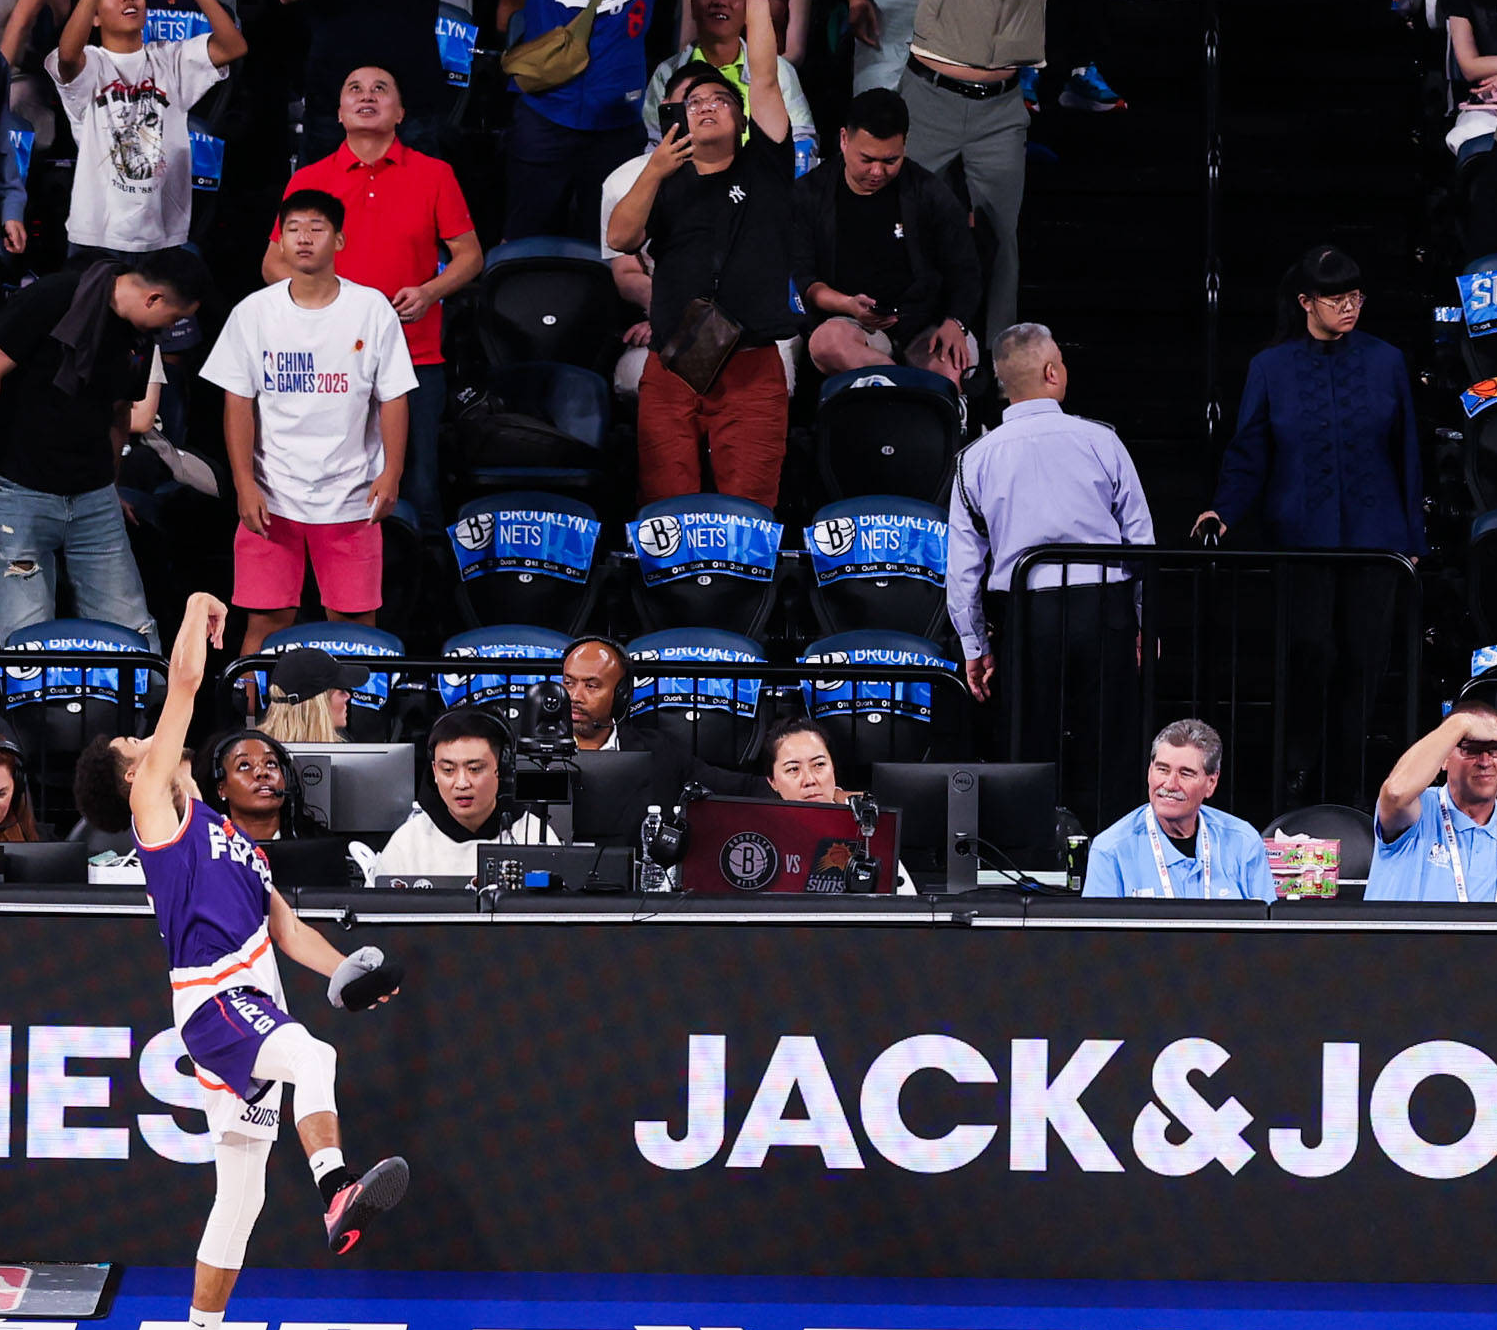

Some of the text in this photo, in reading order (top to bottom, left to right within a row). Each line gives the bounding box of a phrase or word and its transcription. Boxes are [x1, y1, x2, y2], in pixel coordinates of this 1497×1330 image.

[276, 351, 315, 373] CHINA
[276, 372, 349, 394] GAMES 2025
[497, 524, 543, 547] NETS
[686, 528, 728, 550] NETS
[855, 529, 900, 551] NETS
[785, 853, 802, 875] VS
[806, 878, 846, 893] SUNS
[239, 1102, 279, 1128] SUNS
